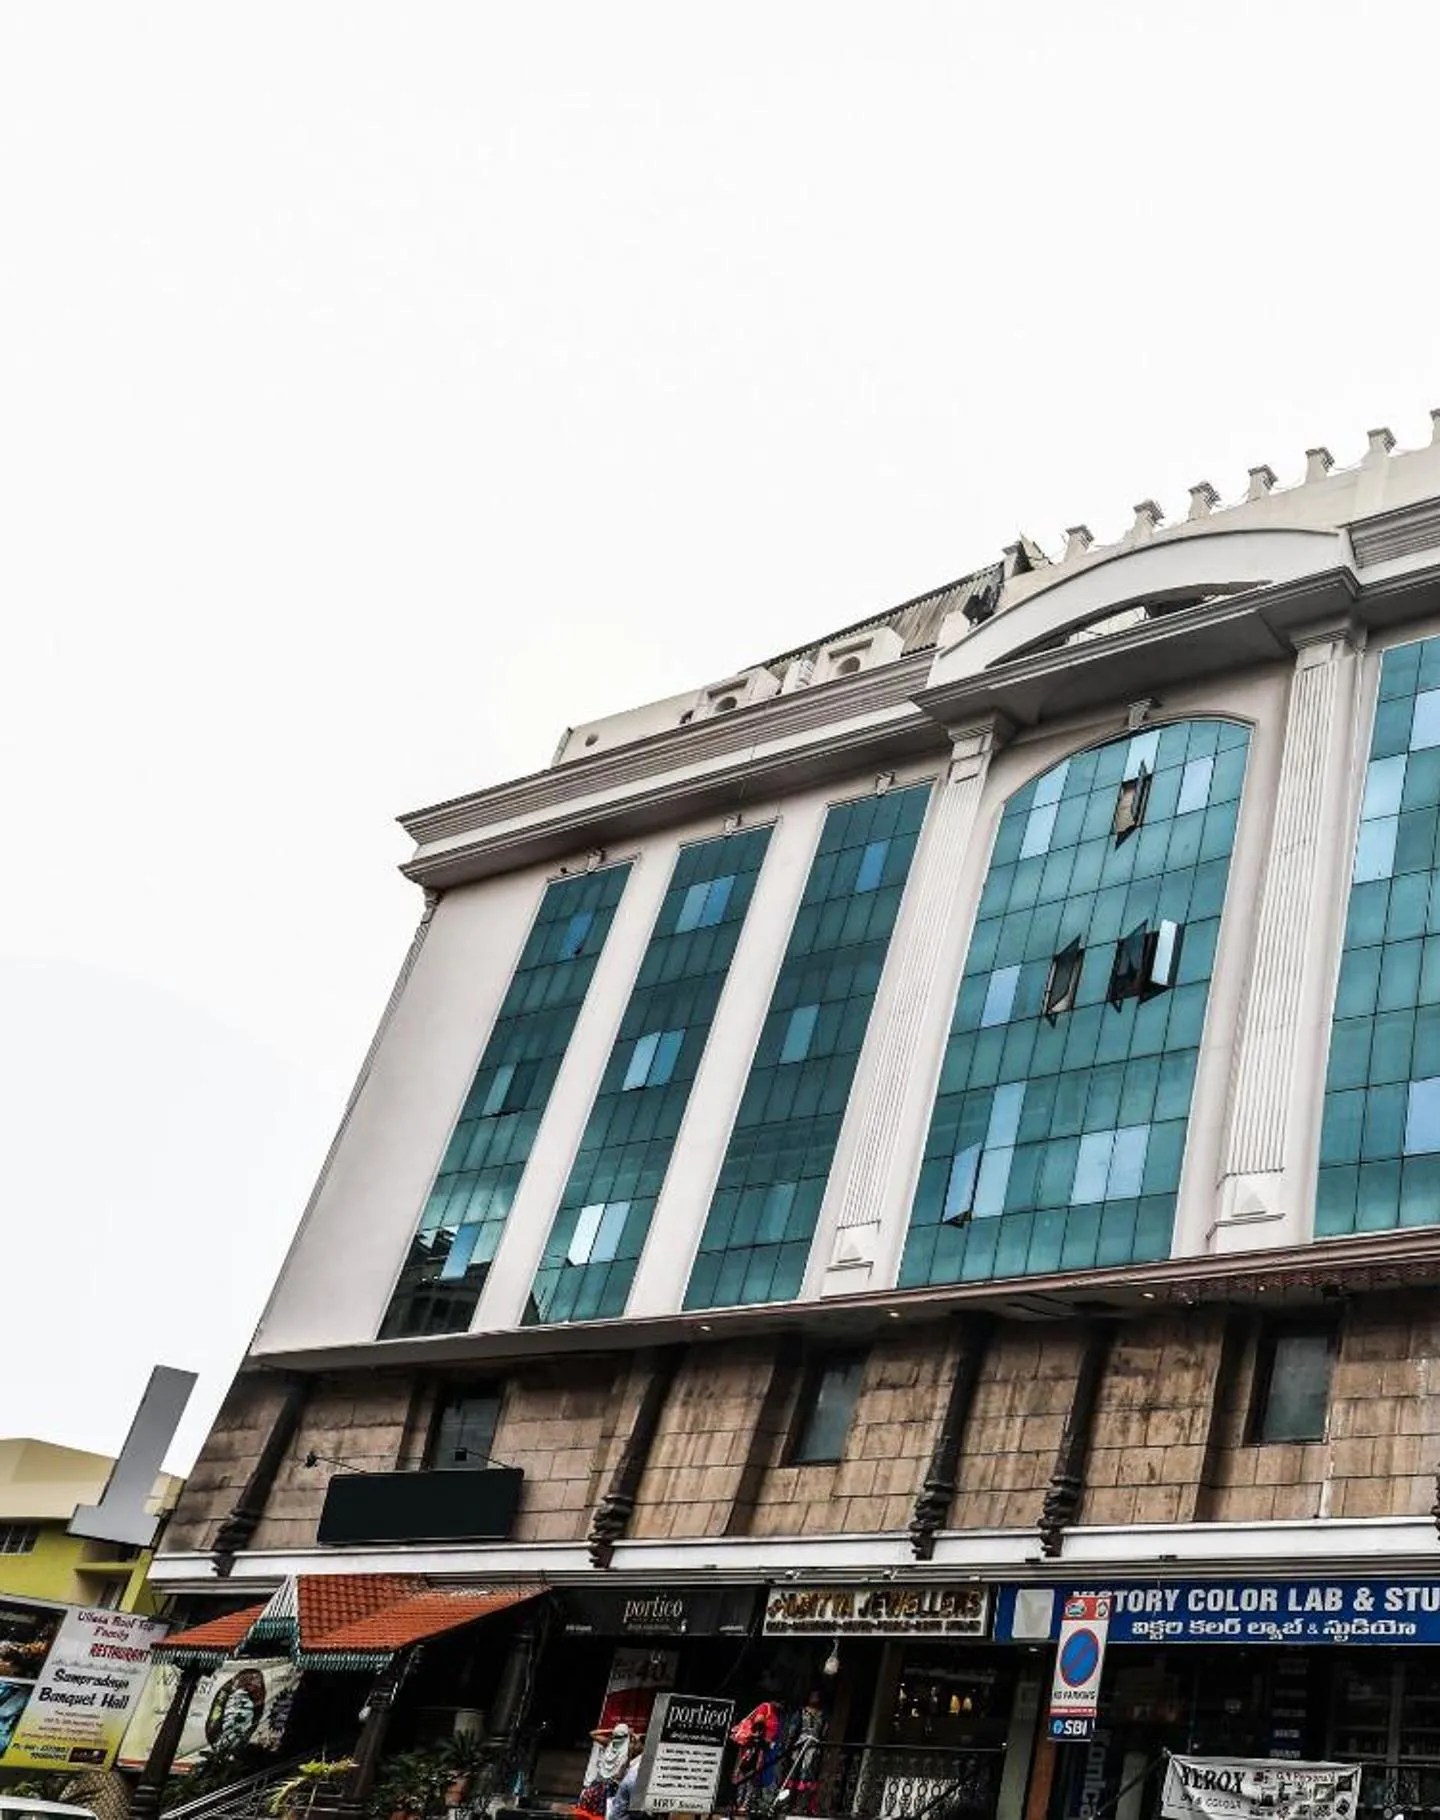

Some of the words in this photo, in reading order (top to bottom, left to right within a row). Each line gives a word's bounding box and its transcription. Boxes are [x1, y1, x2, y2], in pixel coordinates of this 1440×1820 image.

[623, 1594, 683, 1624] portico
[1188, 1588, 1278, 1612] COLOR
[1288, 1587, 1343, 1612] LAB
[1353, 1587, 1375, 1611] &
[1189, 1618, 1242, 1634] కలర్
[1307, 1623, 1319, 1635] &
[38, 1687, 97, 1707] Banquet
[101, 1693, 130, 1709] Hall
[666, 1704, 729, 1728] portico
[1063, 1720, 1087, 1736] SBI
